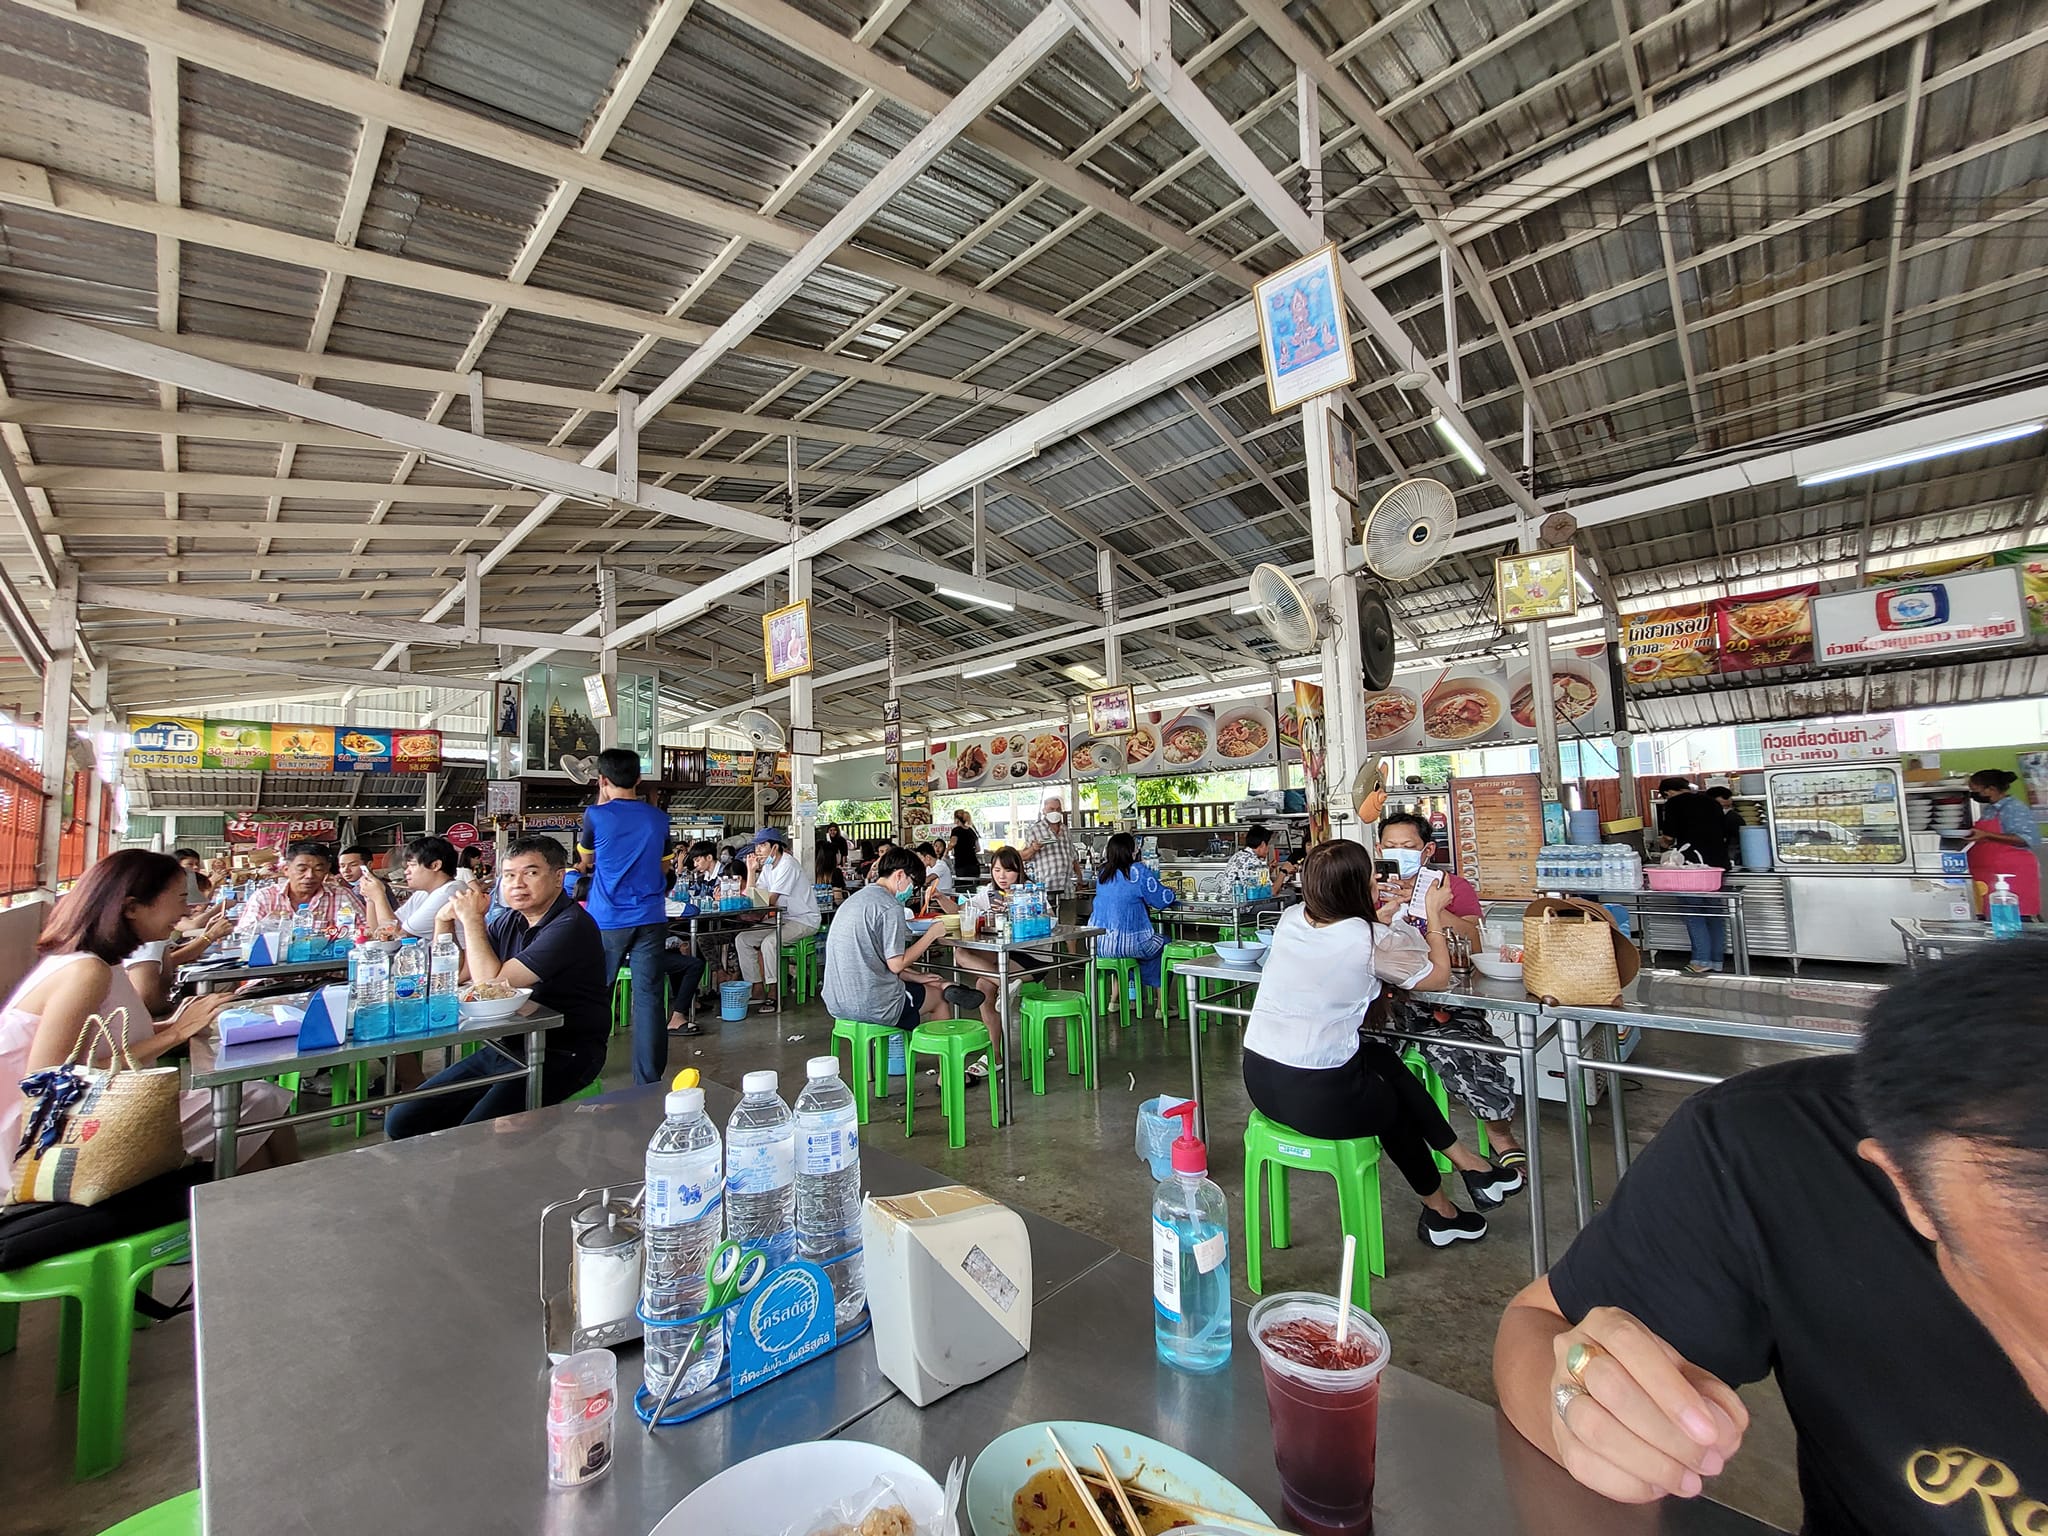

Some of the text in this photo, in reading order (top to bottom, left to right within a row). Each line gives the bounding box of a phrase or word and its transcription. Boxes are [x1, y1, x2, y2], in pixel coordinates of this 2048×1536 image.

[1672, 637, 1690, 651] 20
[1763, 726, 1868, 749] ก๋วยเตี๋ยวต้มยำ
[133, 754, 198, 765] 034751049
